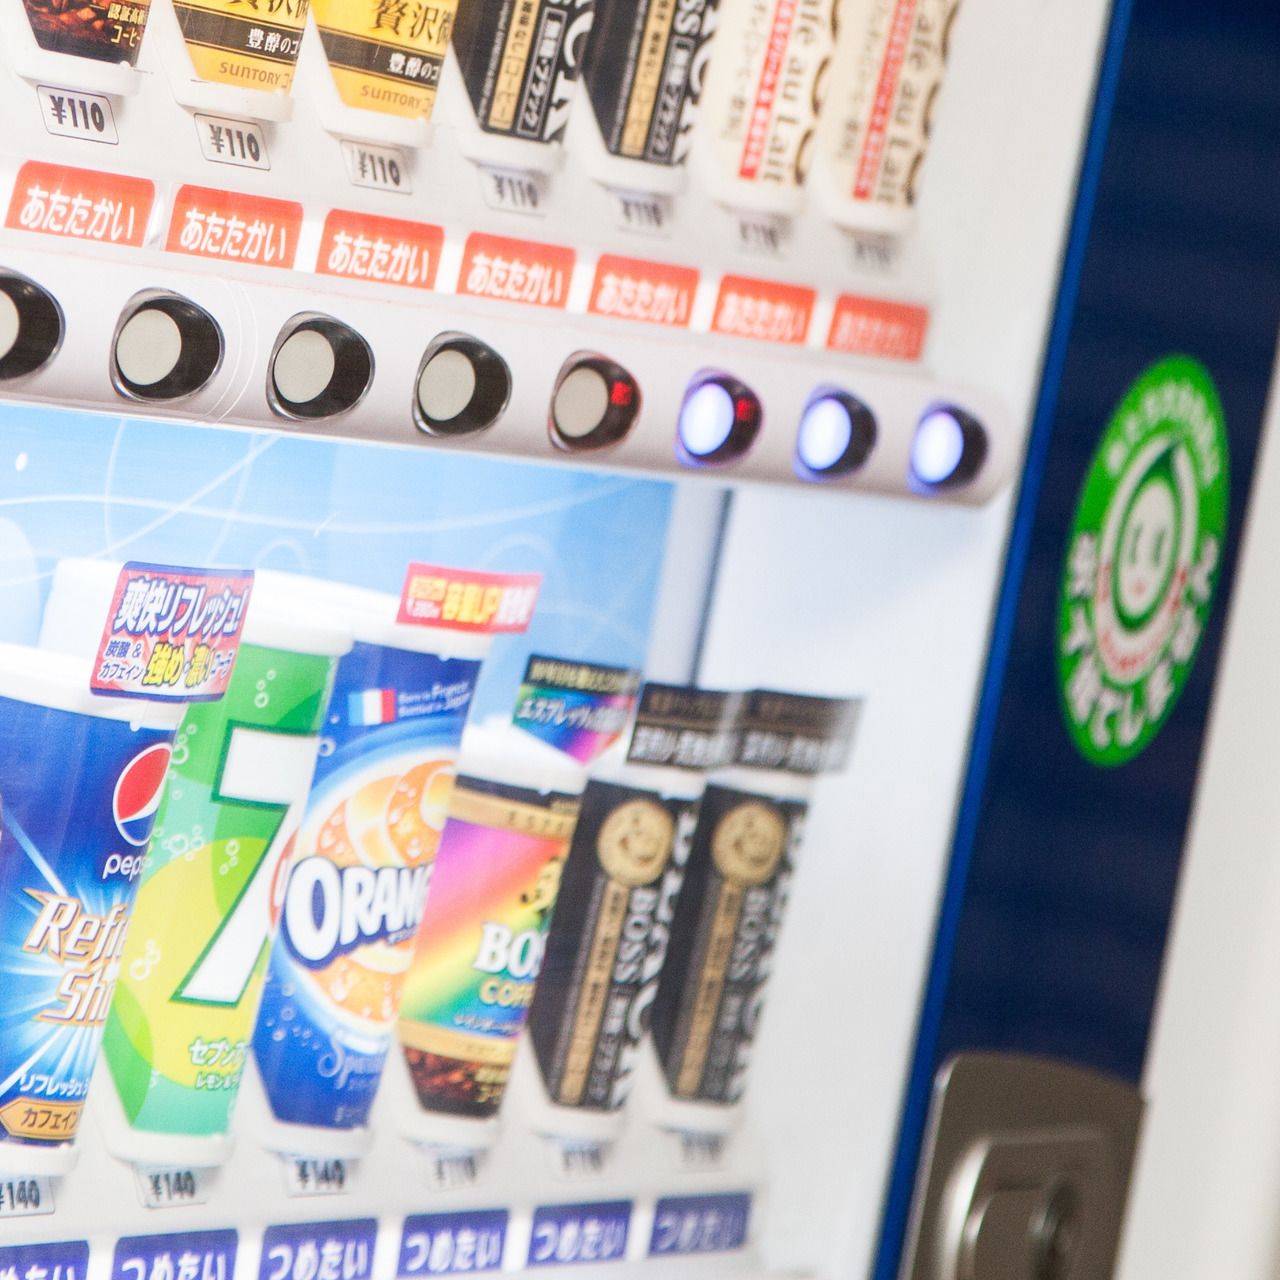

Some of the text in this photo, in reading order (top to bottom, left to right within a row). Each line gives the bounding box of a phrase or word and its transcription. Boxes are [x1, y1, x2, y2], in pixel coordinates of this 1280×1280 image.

[50, 95, 106, 134] ¥110
[208, 125, 260, 163] ¥110
[355, 149, 401, 188] ¥110
[20, 184, 135, 242] あたたかい
[181, 207, 287, 261] あたたかい
[328, 230, 429, 284] あたたかい
[468, 252, 562, 305] あたたかい
[596, 273, 689, 323] あたたかい
[111, 577, 250, 637] 爽快リフレッシュ!
[106, 639, 142, 659] 炭酸 &
[99, 663, 145, 681] カフェイン
[150, 1171, 196, 1200] ¥140
[296, 1160, 346, 1190] ¥140
[405, 1229, 502, 1273] つめたい
